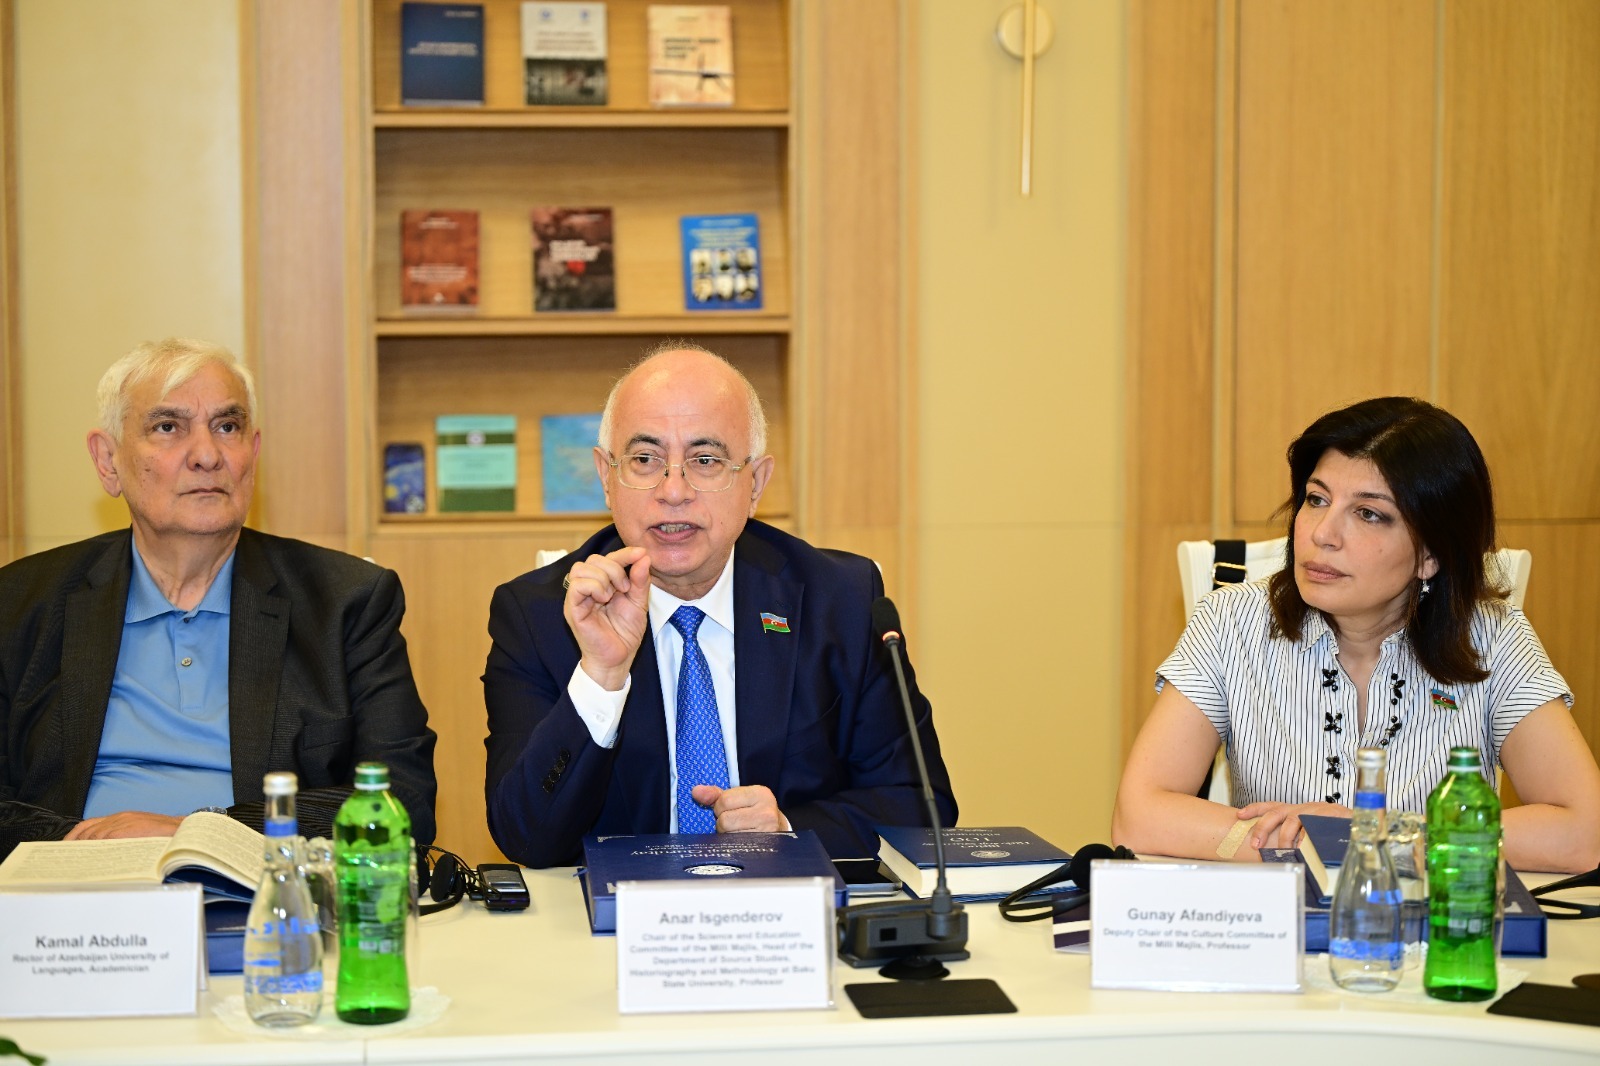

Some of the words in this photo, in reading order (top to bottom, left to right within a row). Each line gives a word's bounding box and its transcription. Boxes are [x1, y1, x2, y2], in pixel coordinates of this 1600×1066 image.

[659, 913, 694, 924] Anar
[700, 911, 783, 926] Isgenderov
[1128, 908, 1174, 923] Gunay
[1180, 909, 1262, 925] Afandiyeva
[642, 933, 666, 941] Chair
[669, 933, 679, 941] of
[681, 932, 694, 940] the
[698, 932, 733, 940] Science
[1103, 928, 1134, 938] Deputy
[1137, 929, 1161, 937] Chair
[1163, 929, 1173, 937] of
[1175, 929, 1188, 937] the
[1192, 930, 1224, 938] Culture
[1278, 931, 1287, 939] of
[35, 936, 84, 948] Kamal
[89, 935, 147, 947] Abdulla
[1139, 940, 1152, 948] the
[1155, 940, 1173, 949] Milli
[1177, 940, 1204, 950] Majlis,
[682, 944, 690, 952] of
[693, 944, 707, 952] the
[710, 943, 727, 951] Milli
[731, 943, 759, 953] Majlis,
[13, 954, 43, 962] Rector
[47, 953, 56, 962] of
[709, 956, 718, 964] of
[755, 955, 790, 963] Studies,
[663, 980, 685, 988] State
